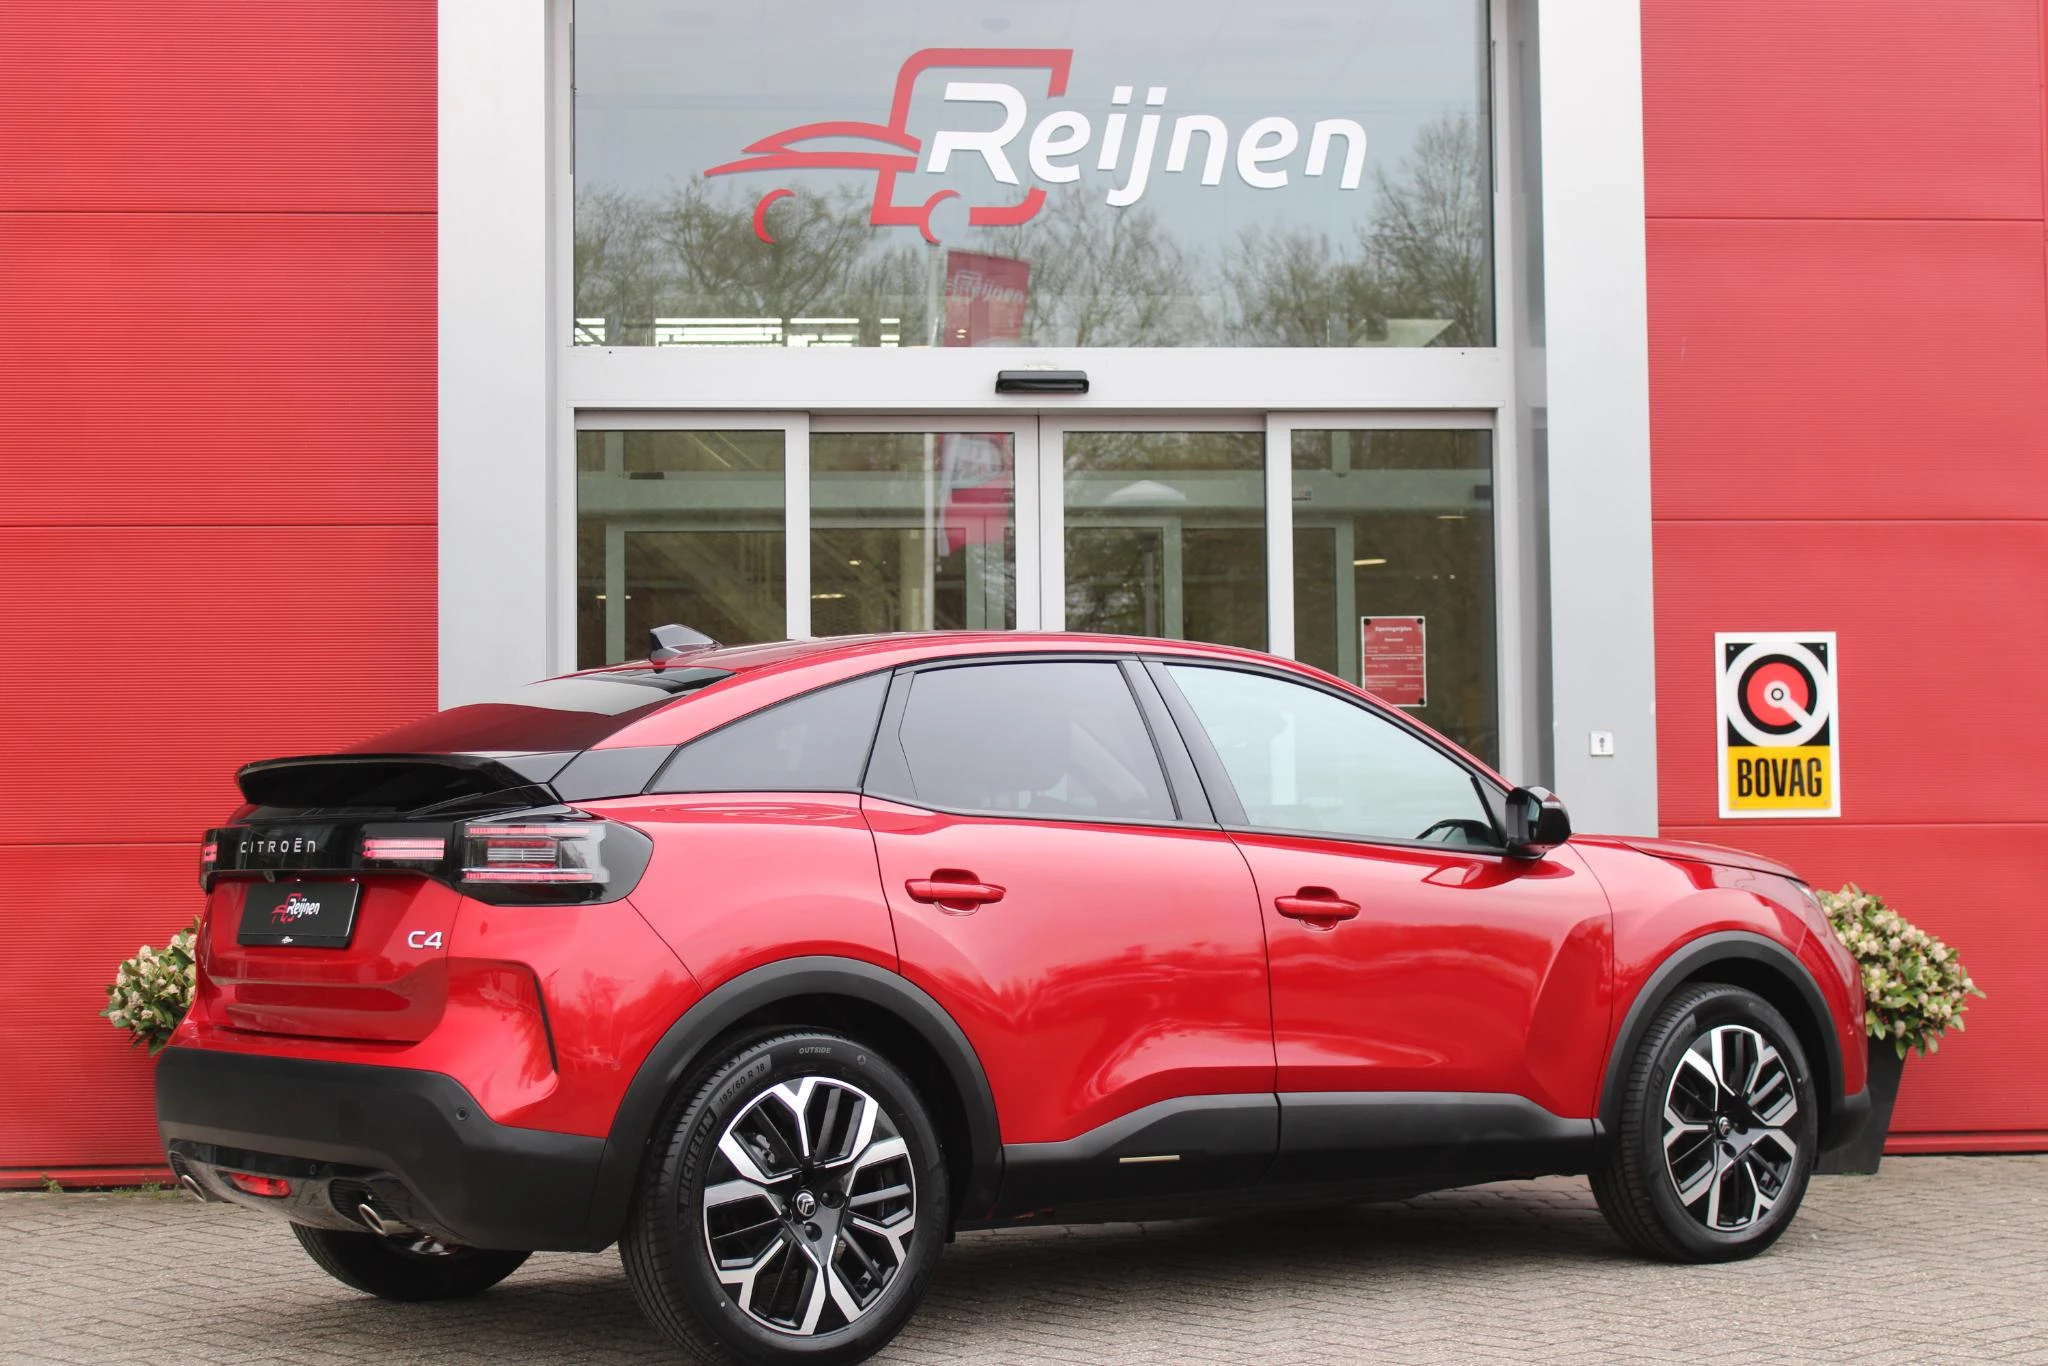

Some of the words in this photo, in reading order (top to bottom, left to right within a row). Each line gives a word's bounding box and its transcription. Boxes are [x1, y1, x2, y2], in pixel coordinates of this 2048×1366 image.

[926, 82, 1367, 207] Reijnen
[1737, 757, 1822, 798] BOVAG
[286, 898, 321, 918] Reijnen
[408, 930, 443, 950] C4
[799, 1046, 832, 1055] OUTSIDE
[719, 1076, 747, 1106] 195/60
[756, 1063, 766, 1074] 18
[678, 1109, 717, 1207] MICHELIN
